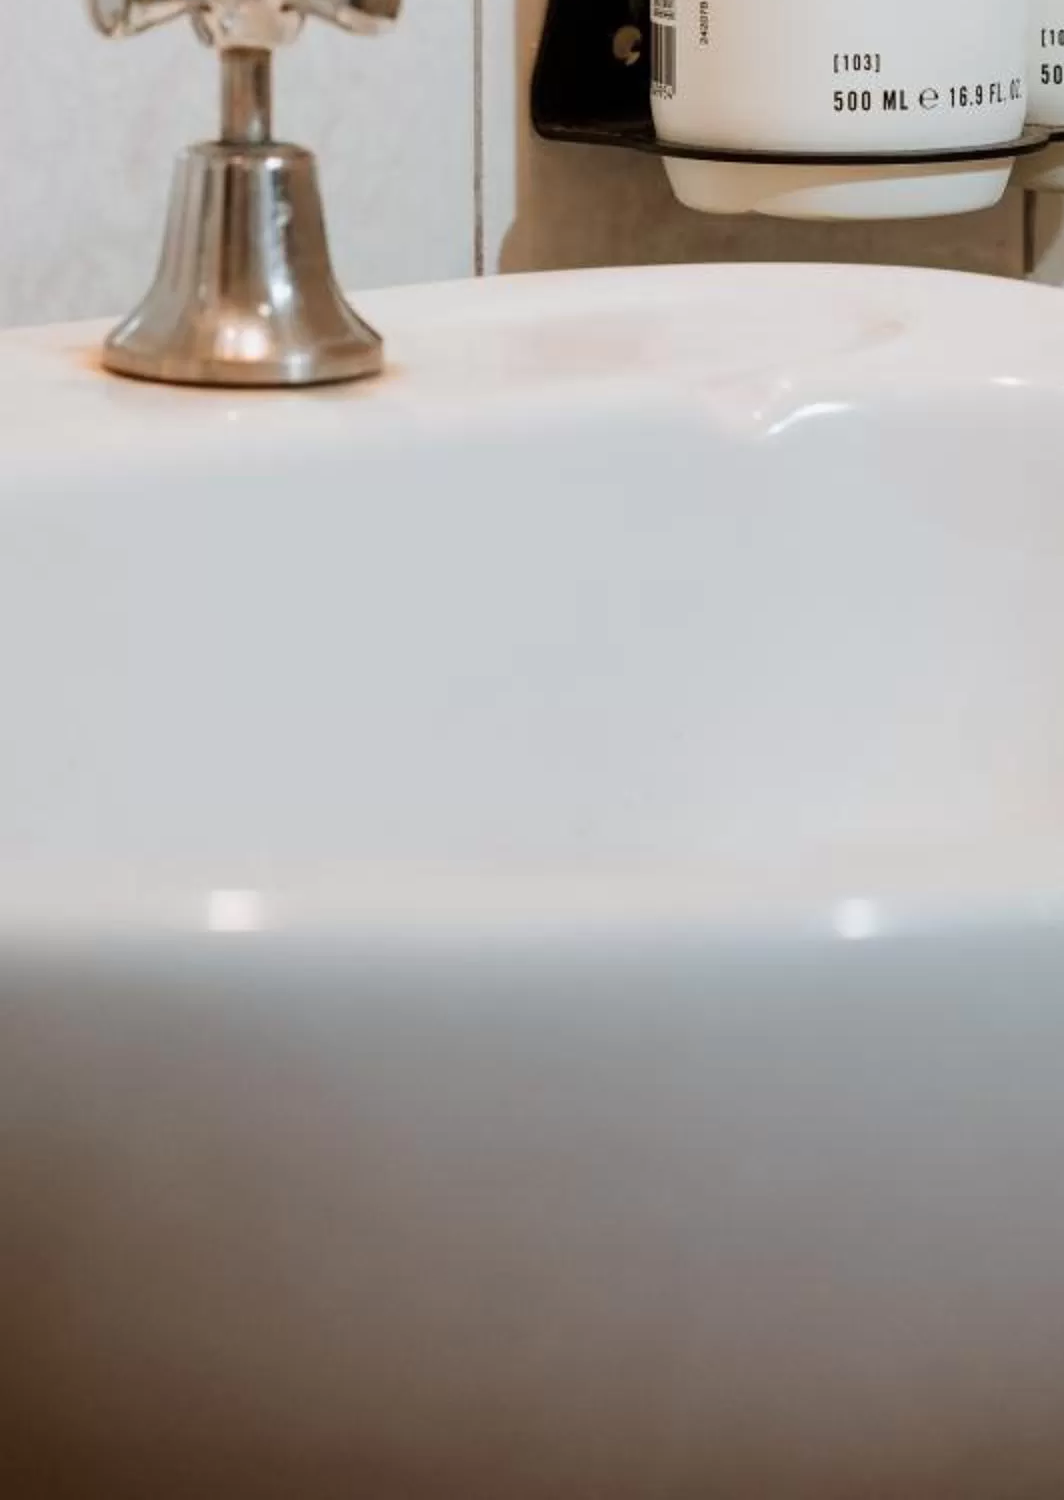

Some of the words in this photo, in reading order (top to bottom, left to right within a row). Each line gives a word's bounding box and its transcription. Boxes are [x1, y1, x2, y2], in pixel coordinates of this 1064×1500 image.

[834, 54, 880, 73] [103]
[834, 90, 871, 112] 500
[883, 90, 908, 110] ML
[950, 85, 983, 108] 16.9
